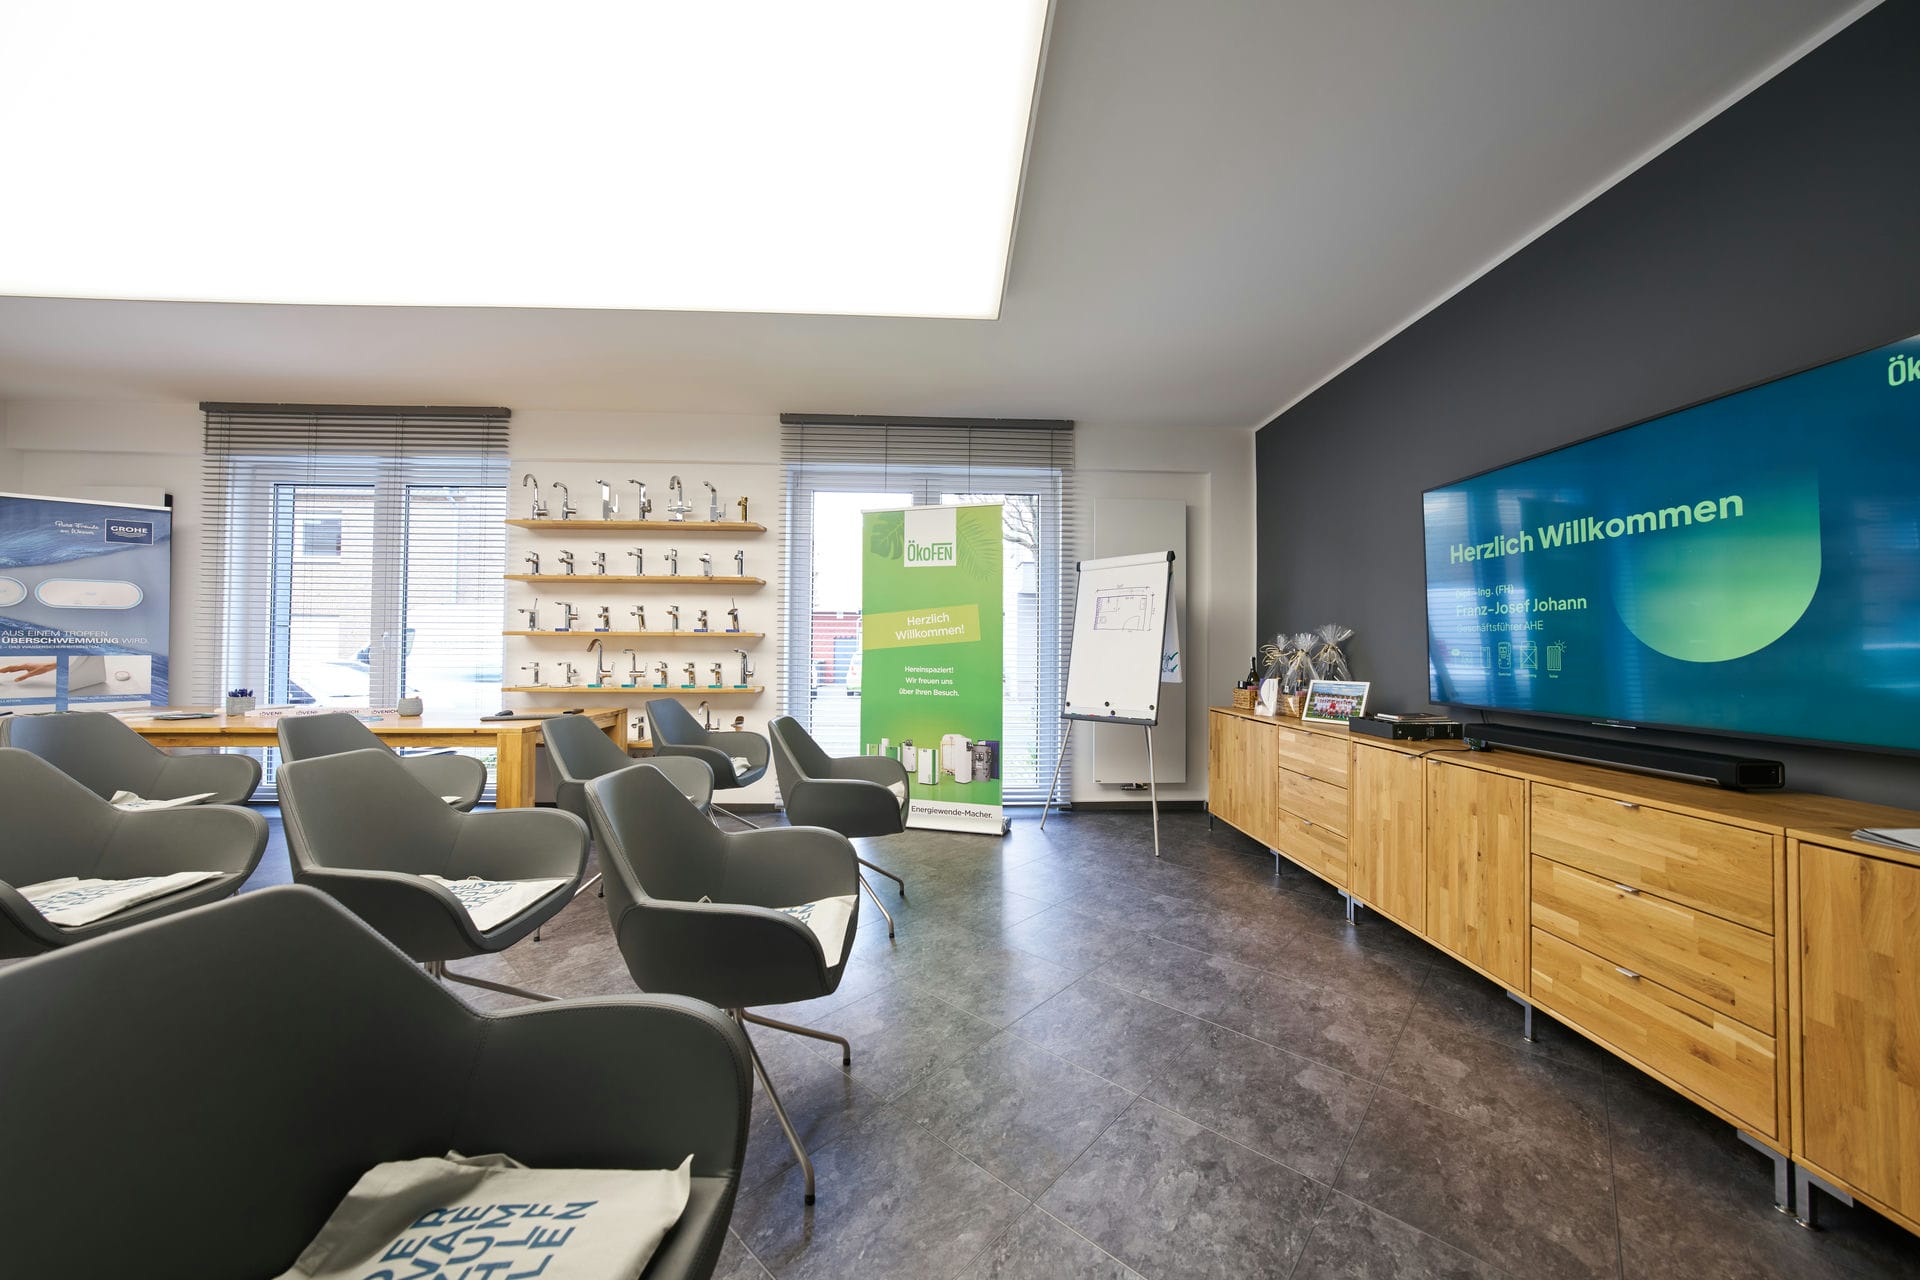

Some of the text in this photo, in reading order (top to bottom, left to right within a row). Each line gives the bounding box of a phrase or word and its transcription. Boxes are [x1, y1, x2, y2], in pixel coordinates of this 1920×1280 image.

[110, 525, 149, 534] GROHE
[1450, 494, 1744, 565] Herzlich Willkommen
[1456, 597, 1587, 617] Franz-Josef Johann
[907, 612, 950, 627] Herzlich
[1525, 620, 1544, 631] AHE
[895, 624, 965, 641] Willkommen!
[1, 635, 119, 645] ÜBERSCHWEMMUNG
[904, 665, 954, 674] Hereinspaziert!
[918, 677, 940, 685] freuen
[911, 805, 993, 819] Energiewende-Macher.
